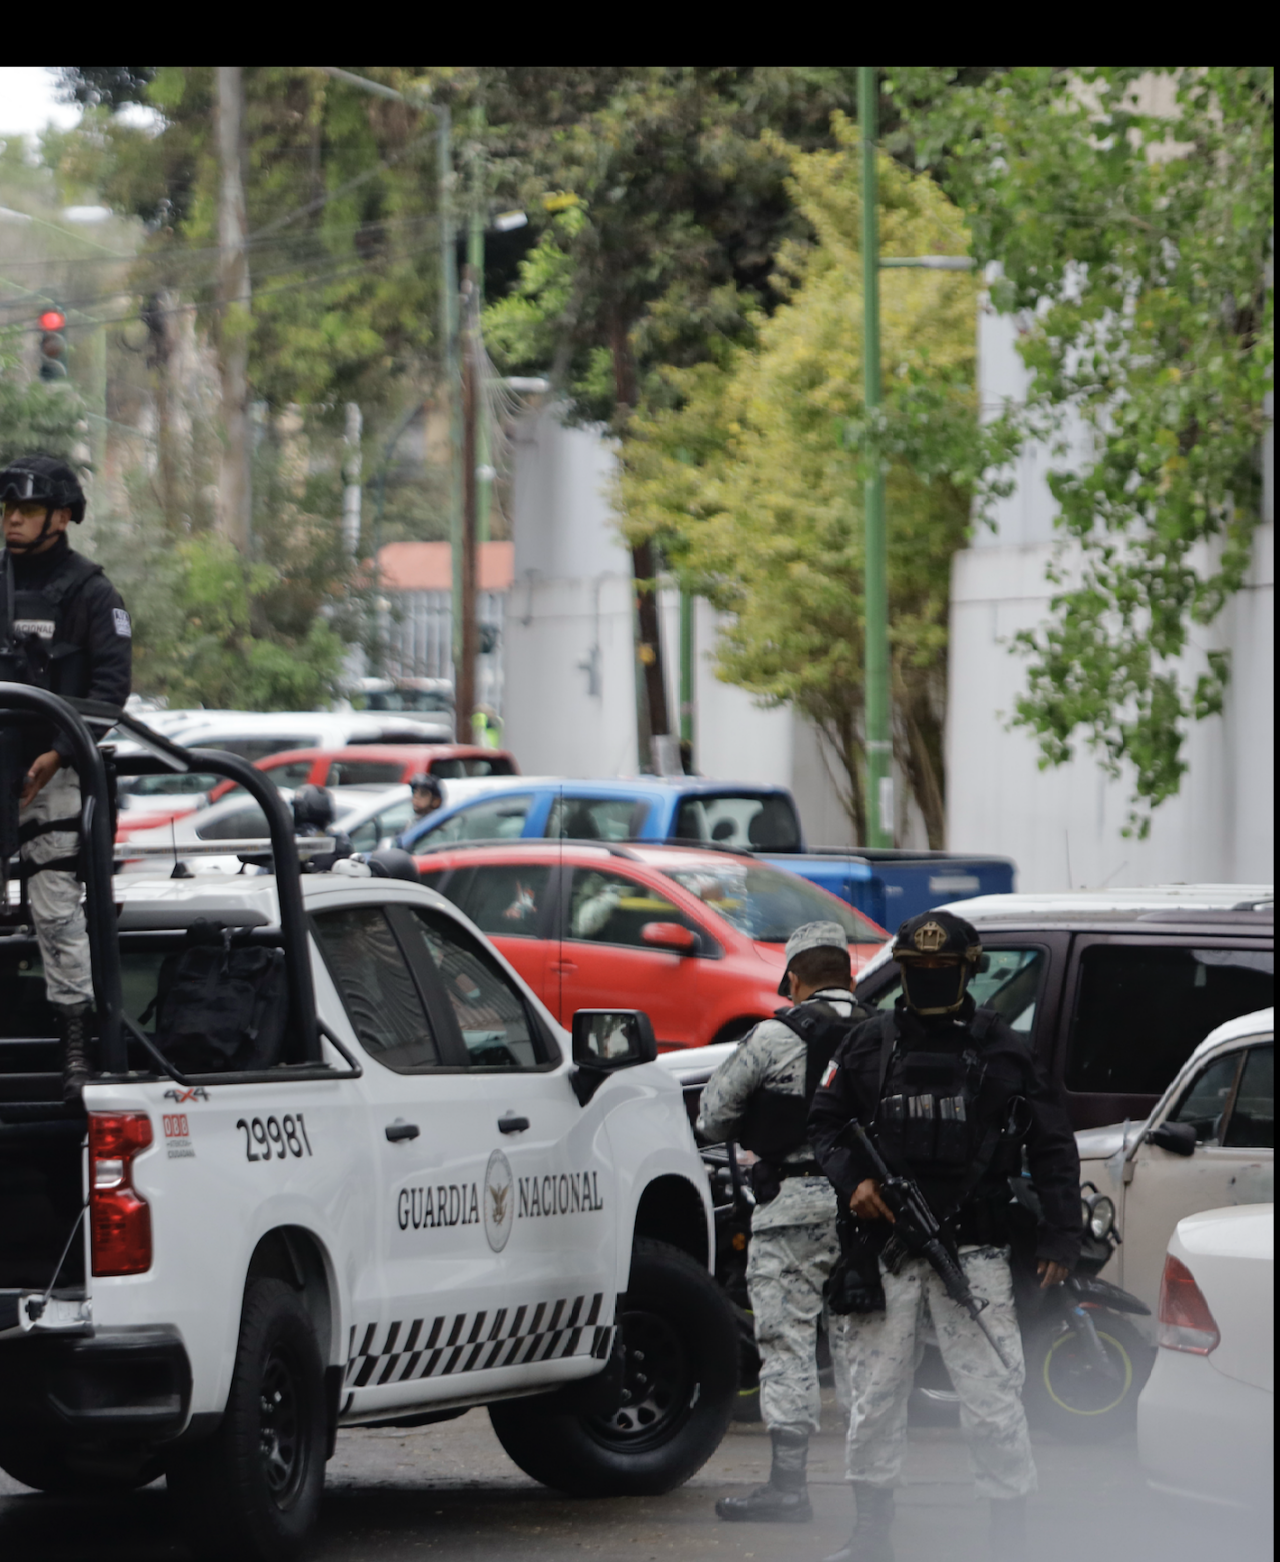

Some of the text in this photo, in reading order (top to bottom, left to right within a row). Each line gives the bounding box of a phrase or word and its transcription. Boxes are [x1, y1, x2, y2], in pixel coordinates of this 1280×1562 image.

[164, 1115, 189, 1137] 088
[236, 1113, 313, 1162] 29981
[397, 1182, 481, 1231] GUARDIA
[518, 1170, 604, 1219] NACIONAL
